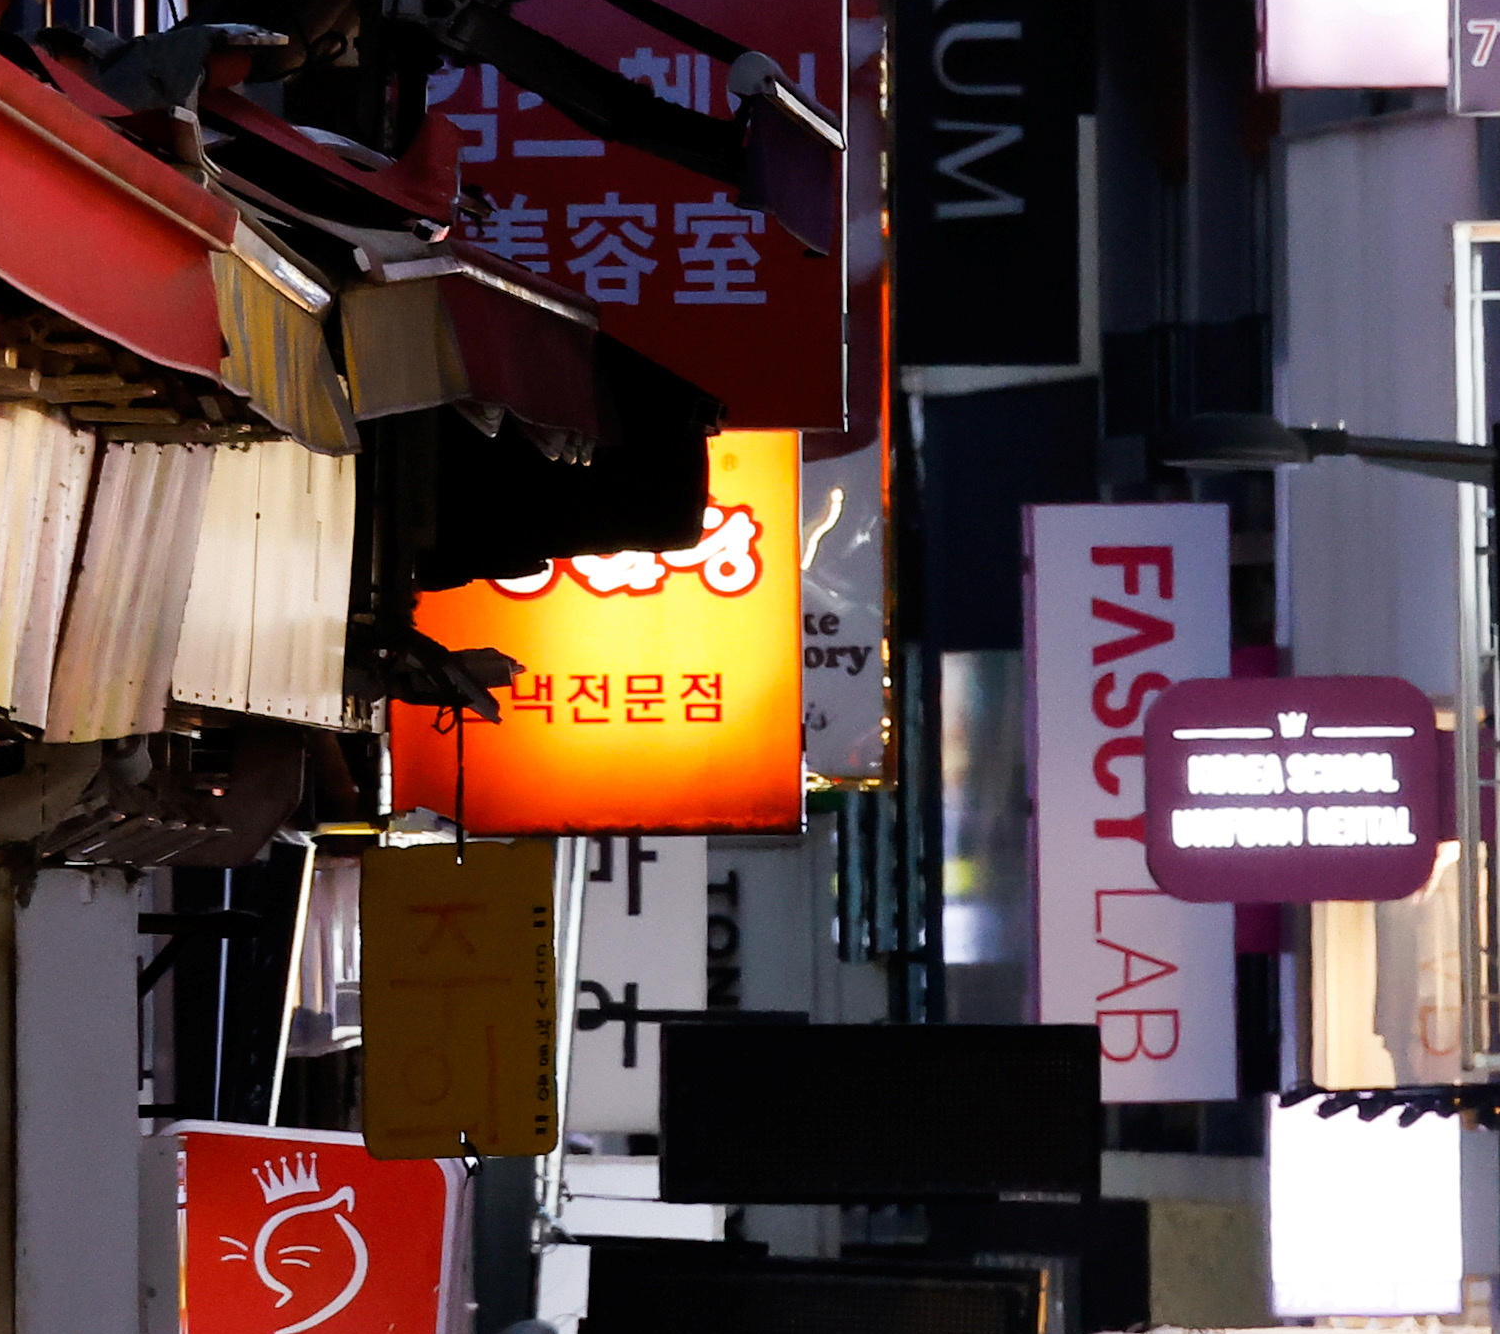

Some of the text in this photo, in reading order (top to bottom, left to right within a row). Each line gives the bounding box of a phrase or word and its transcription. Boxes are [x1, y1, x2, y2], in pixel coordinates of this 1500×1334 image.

[458, 673, 724, 726] 낵전문점
[1187, 751, 1400, 795] KOREA SCHOOL
[1172, 804, 1417, 849] UNIFORM RENTAL
[1092, 887, 1182, 1064] LAB
